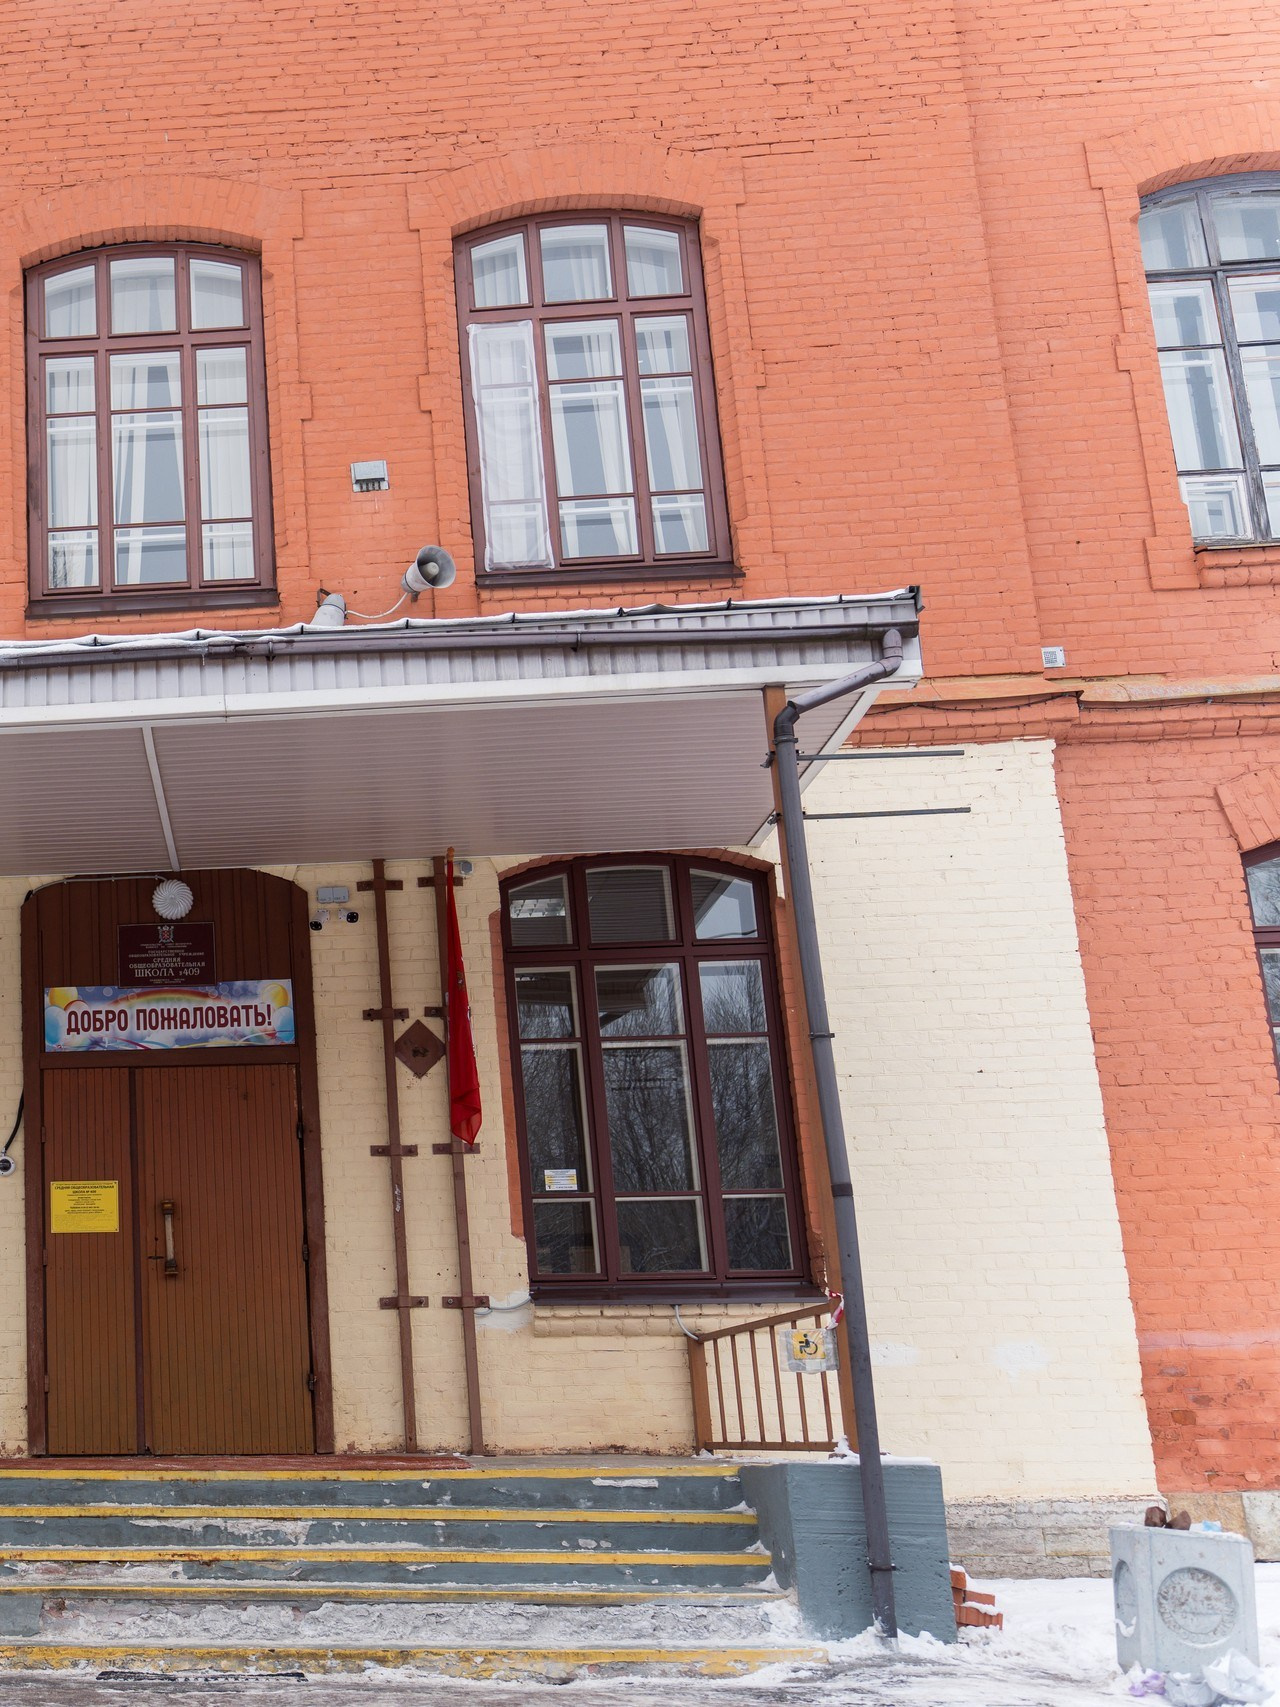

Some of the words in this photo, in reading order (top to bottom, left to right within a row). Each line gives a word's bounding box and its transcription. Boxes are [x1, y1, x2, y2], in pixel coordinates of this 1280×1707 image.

[135, 968, 174, 977] ШКОЛА
[66, 1008, 129, 1035] ДОБРО
[136, 1003, 273, 1031] ПОЖАЛОВАТЬ!
